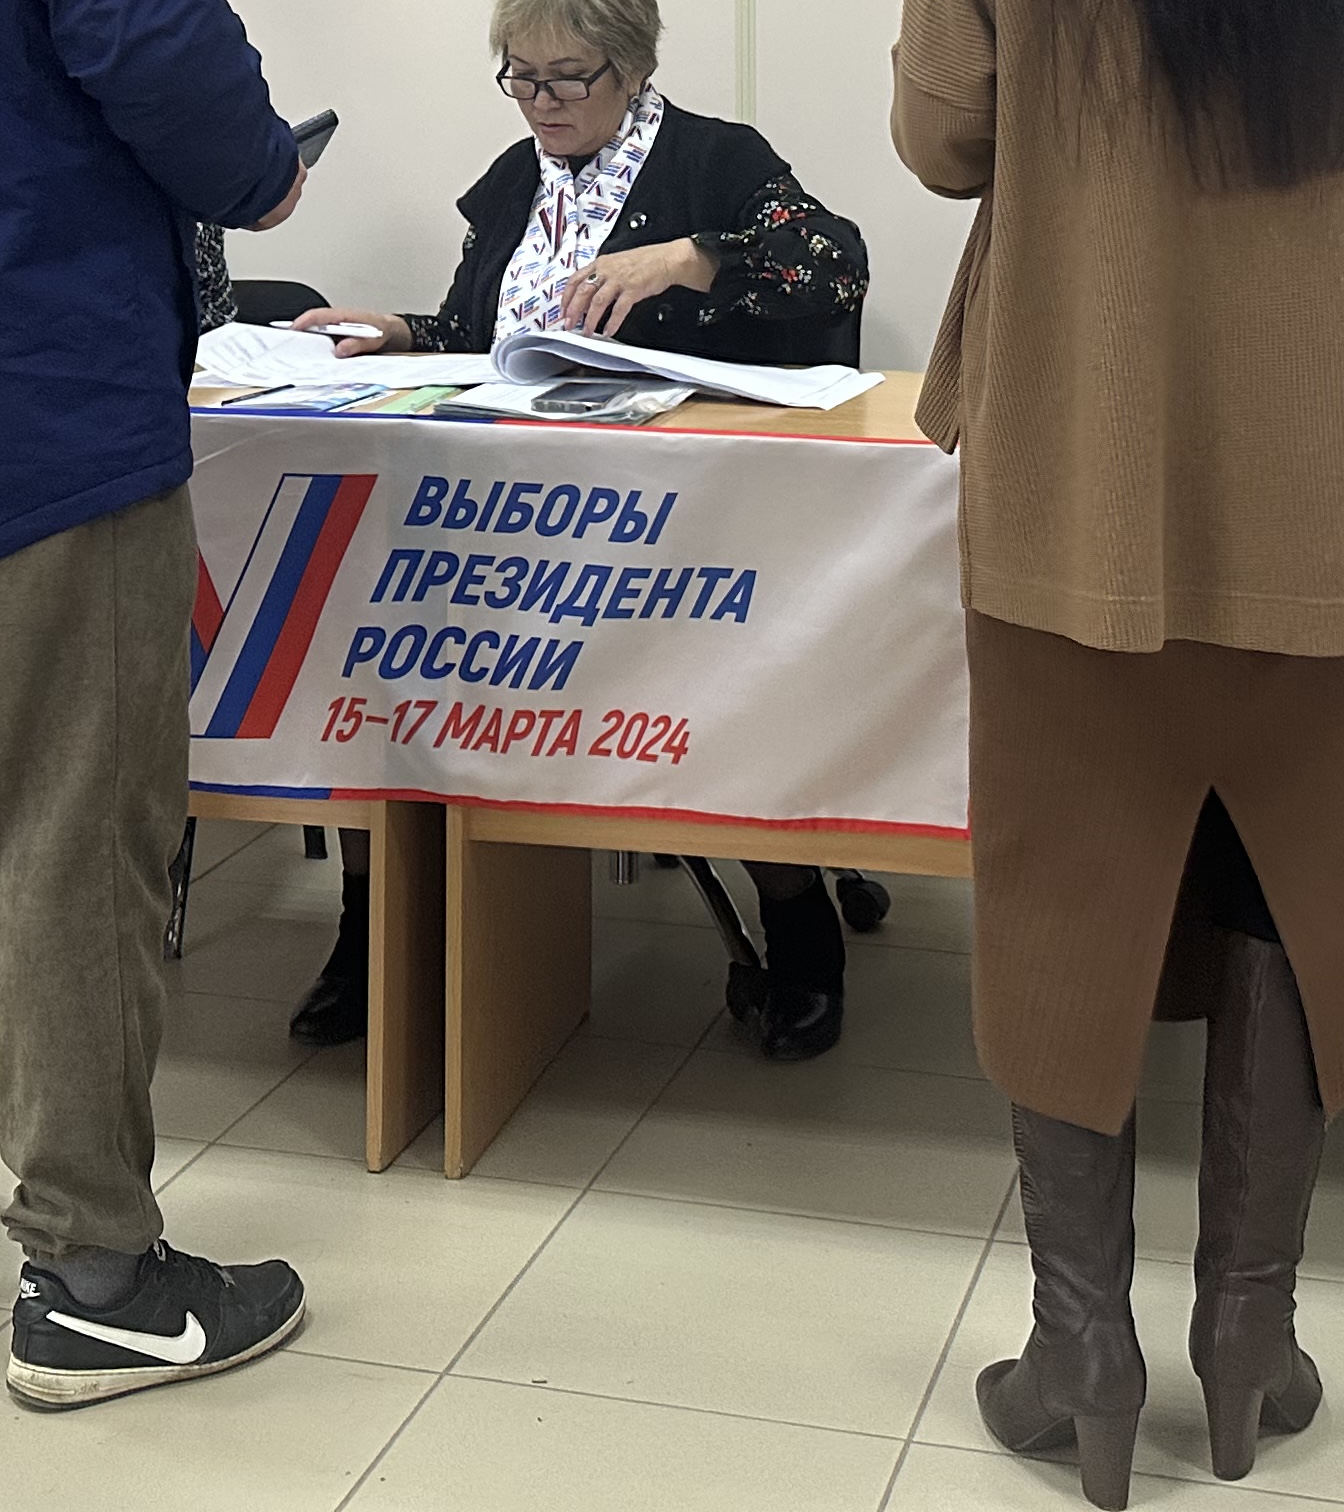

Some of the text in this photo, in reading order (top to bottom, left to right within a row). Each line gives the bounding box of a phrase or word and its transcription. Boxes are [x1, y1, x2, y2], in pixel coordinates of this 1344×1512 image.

[403, 475, 678, 546] ВЫБОРЫ
[368, 548, 758, 627] ПРЕЗИДЕНТА
[341, 624, 584, 692] РОССИИ
[433, 701, 582, 758] МАРТА
[588, 713, 691, 766] 2024
